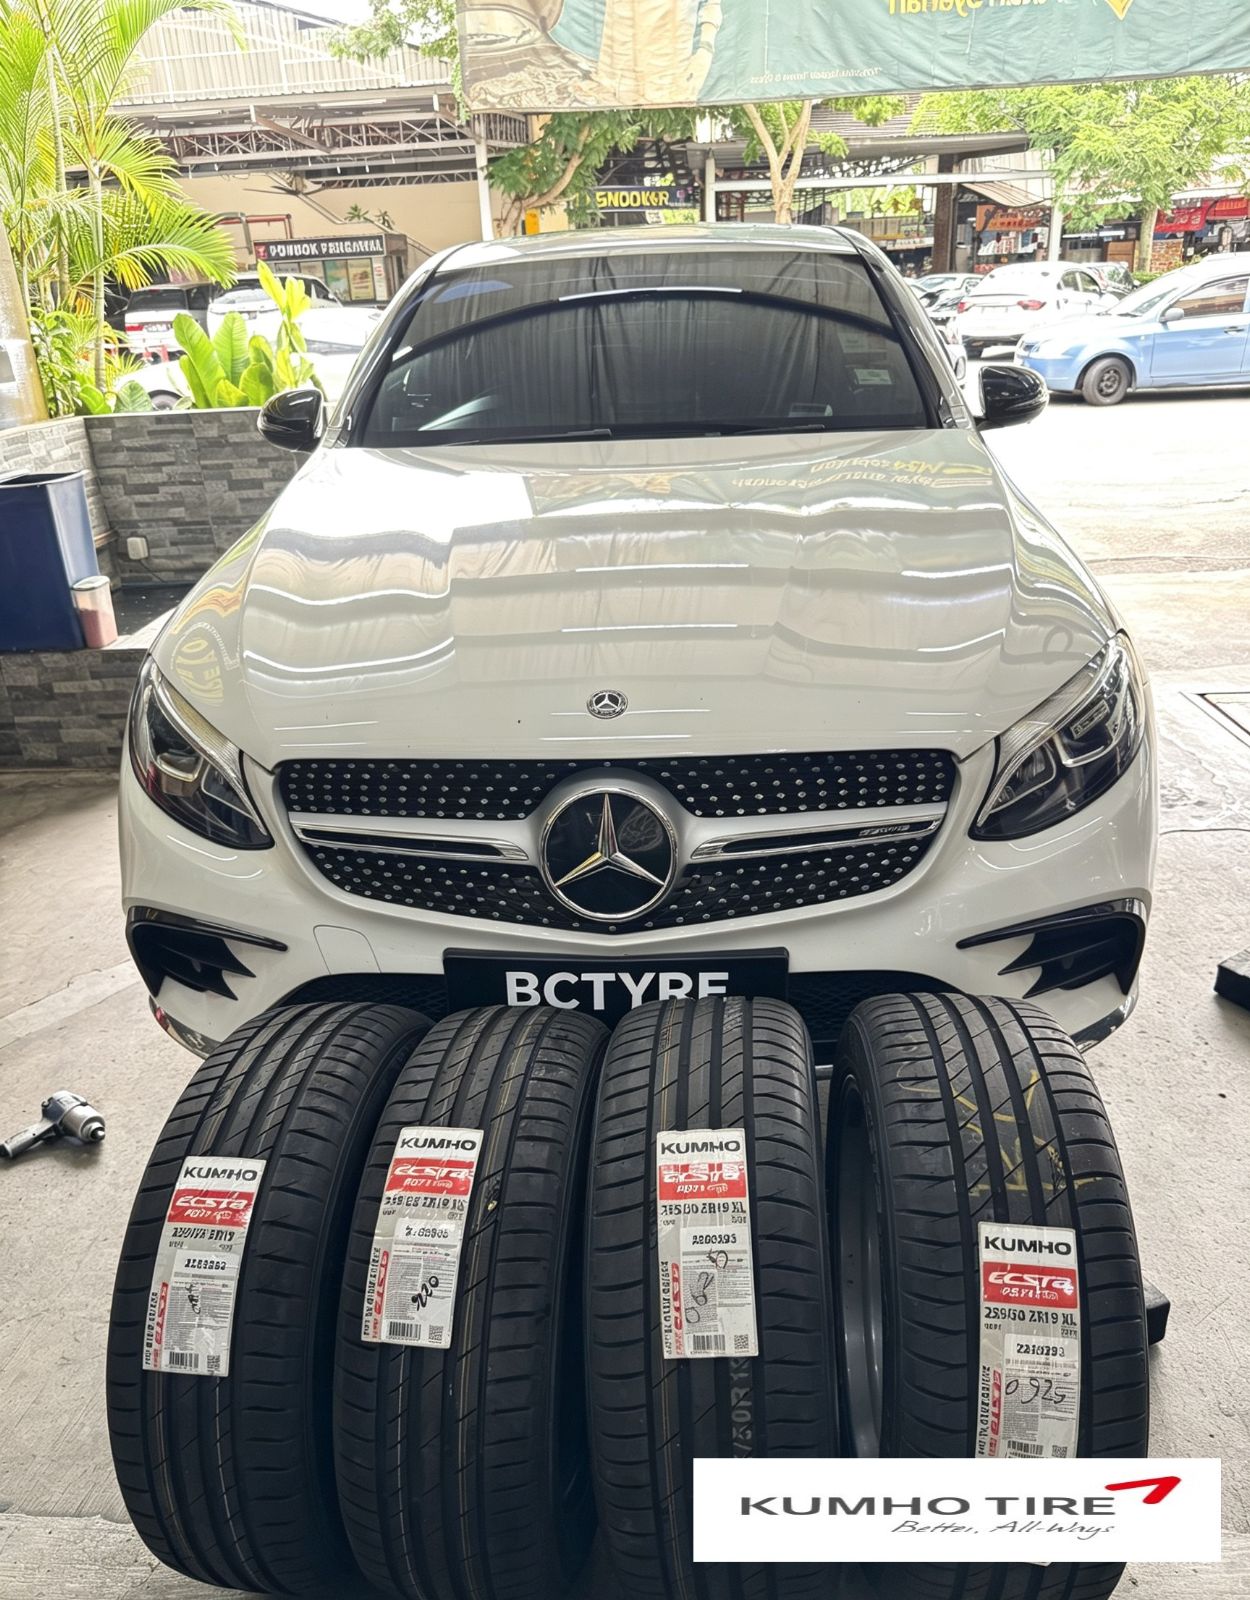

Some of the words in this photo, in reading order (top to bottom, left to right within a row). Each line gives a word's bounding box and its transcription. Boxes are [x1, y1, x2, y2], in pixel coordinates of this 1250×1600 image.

[505, 971, 729, 1011] BCTYRE
[400, 1137, 477, 1151] KUMHO
[661, 1140, 741, 1155] KUMHO
[183, 1166, 258, 1181] KUMHO
[984, 1236, 1072, 1255] KUMHO
